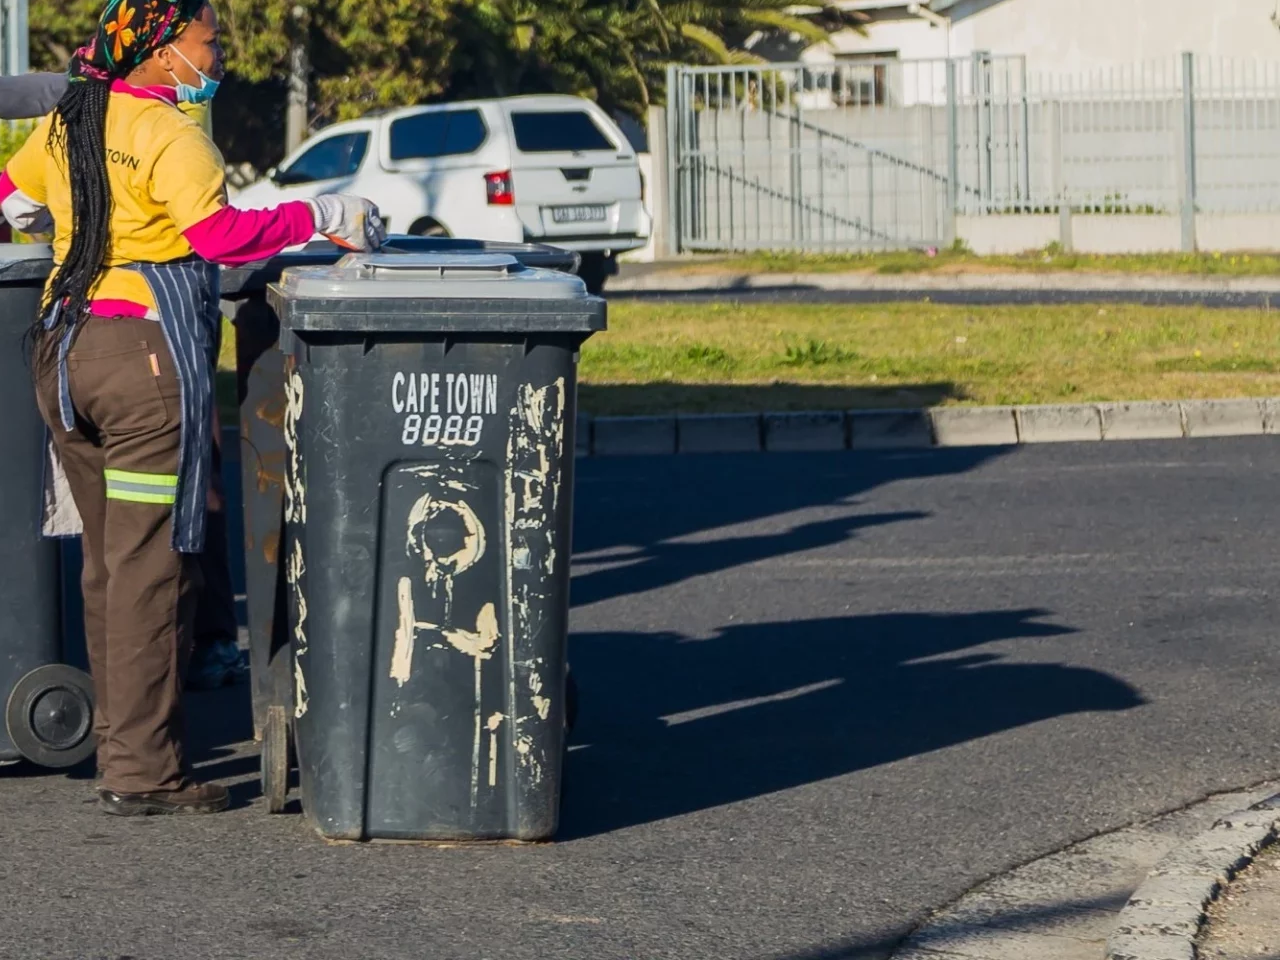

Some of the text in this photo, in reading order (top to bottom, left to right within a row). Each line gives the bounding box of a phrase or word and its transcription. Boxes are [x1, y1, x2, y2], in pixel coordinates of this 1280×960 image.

[391, 371, 498, 415] CAPE TOWN
[401, 414, 484, 446] 8888
